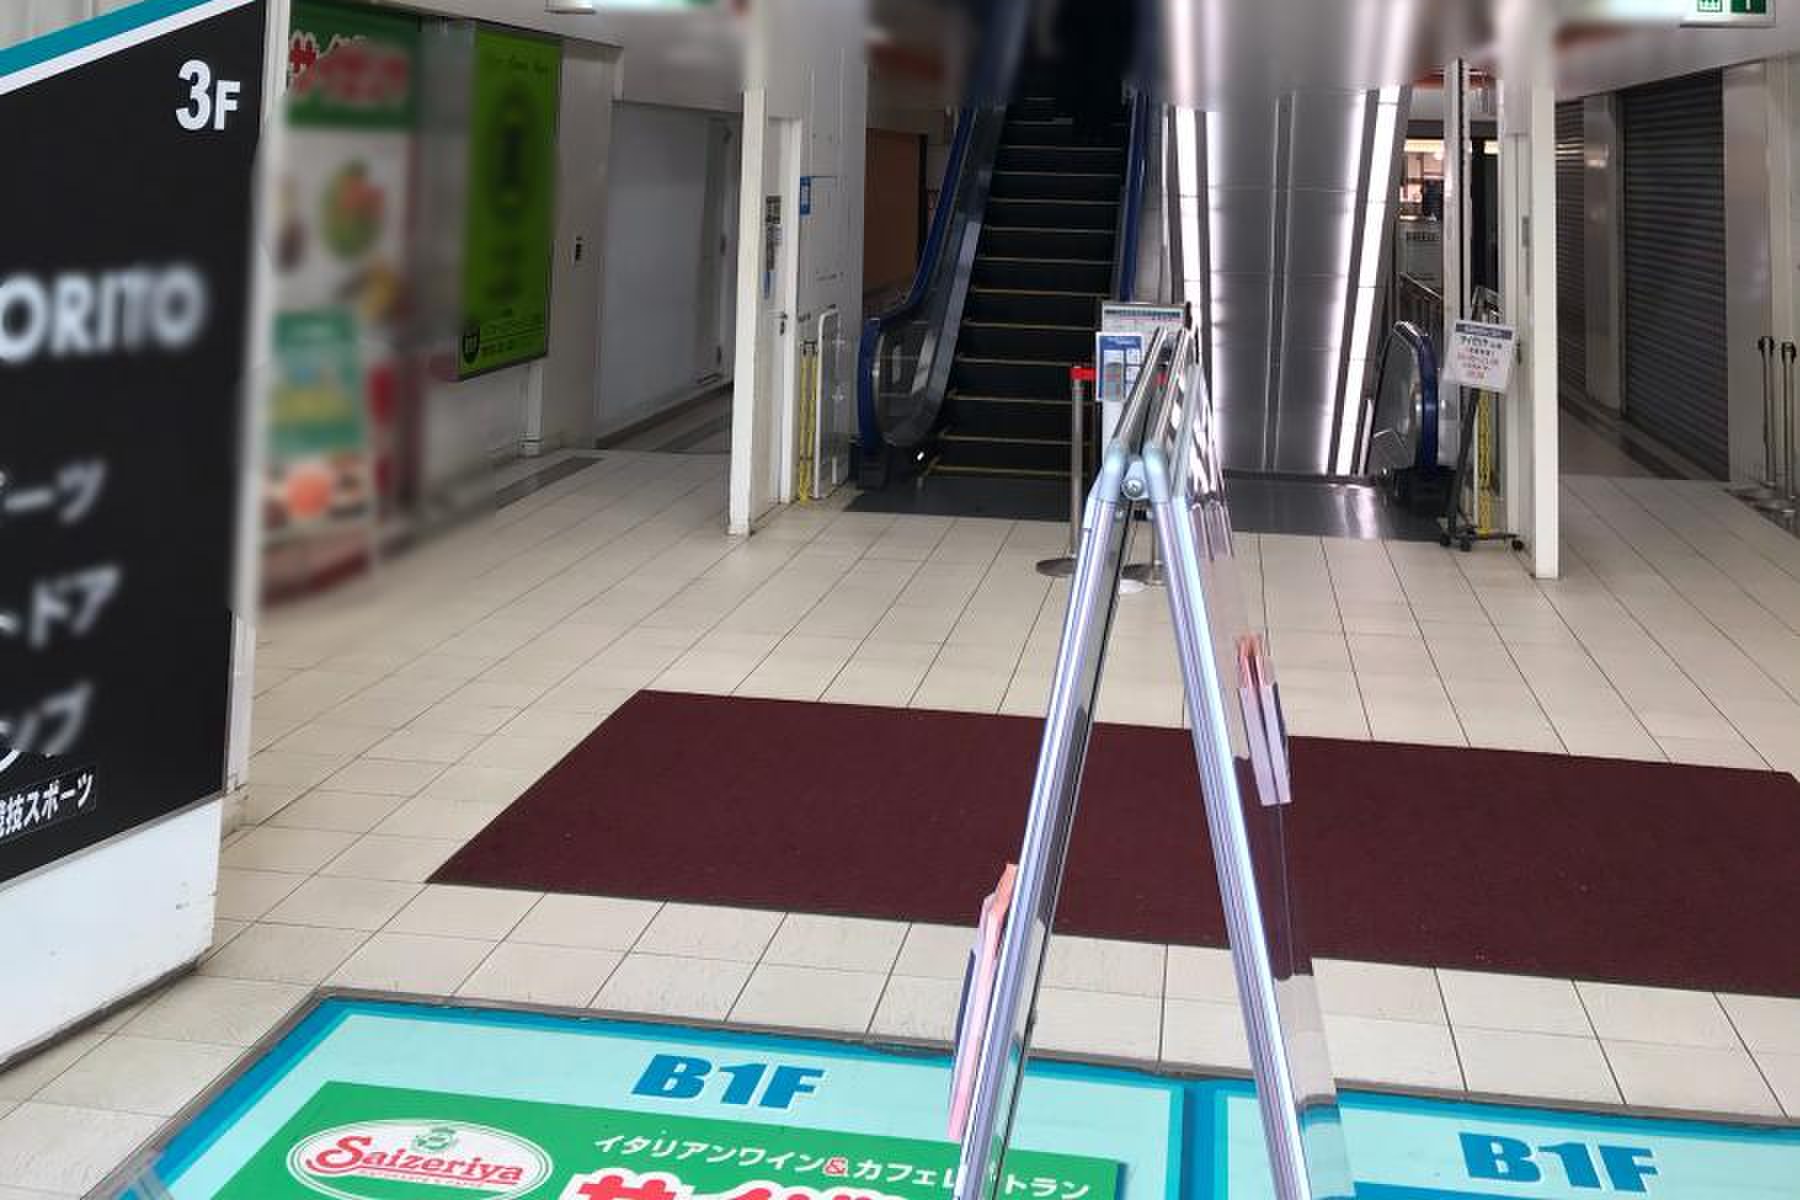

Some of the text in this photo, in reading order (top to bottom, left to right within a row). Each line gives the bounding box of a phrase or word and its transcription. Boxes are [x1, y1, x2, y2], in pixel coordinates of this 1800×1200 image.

[176, 60, 241, 130] 3F
[632, 1054, 824, 1109] B1F
[305, 1136, 523, 1185] Saizeriya
[1458, 1132, 1658, 1193] B1F
